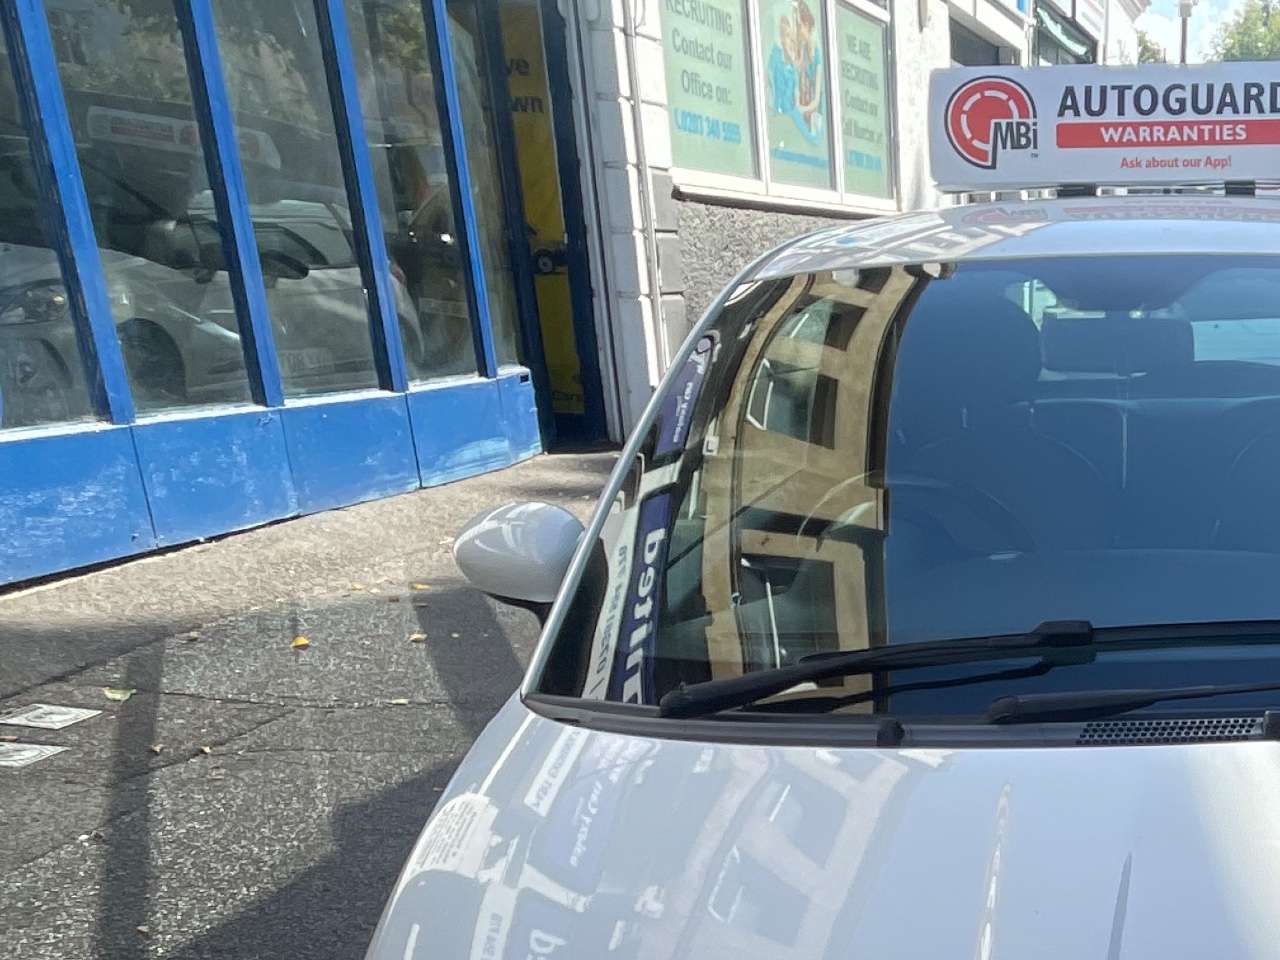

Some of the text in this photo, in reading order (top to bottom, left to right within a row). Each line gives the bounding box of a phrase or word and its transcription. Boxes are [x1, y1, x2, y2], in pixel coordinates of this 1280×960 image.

[671, 27, 715, 66] Contact
[680, 68, 713, 101] Office
[1101, 124, 1248, 143] WARRANTIES
[1120, 156, 1232, 169] Ask about our App!
